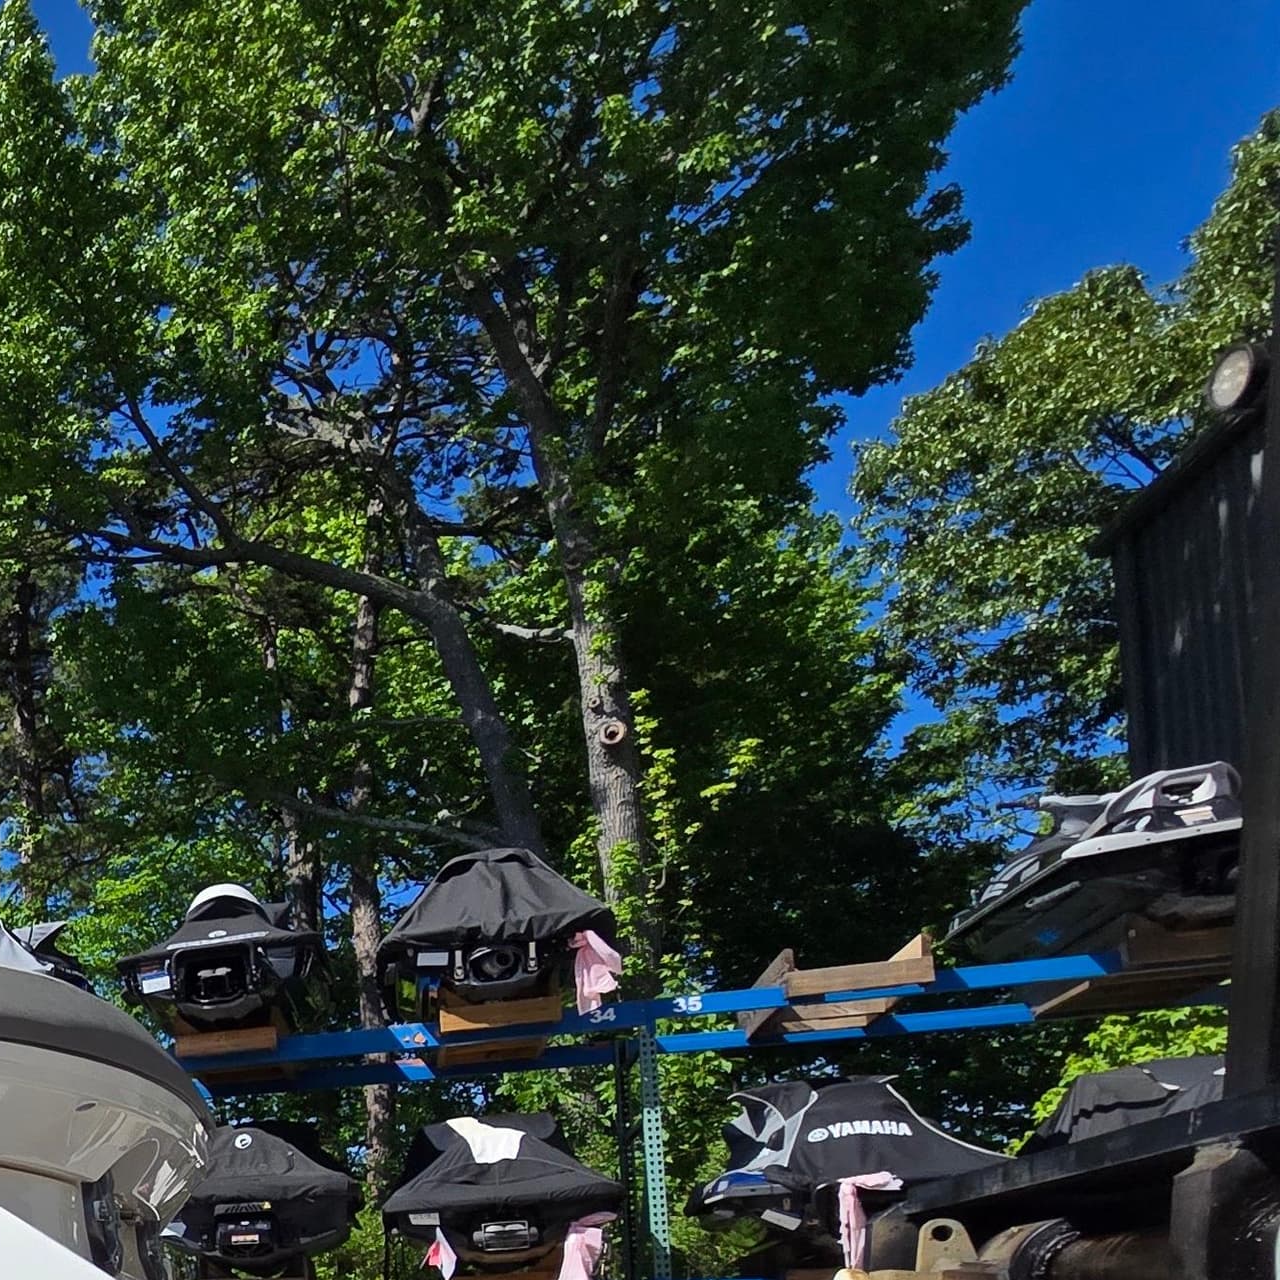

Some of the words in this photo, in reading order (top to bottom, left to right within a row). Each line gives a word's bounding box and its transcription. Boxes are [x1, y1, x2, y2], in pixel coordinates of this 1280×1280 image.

[672, 996, 702, 1014] 35
[589, 1008, 616, 1023] 34
[827, 1120, 912, 1139] YAMAHA
